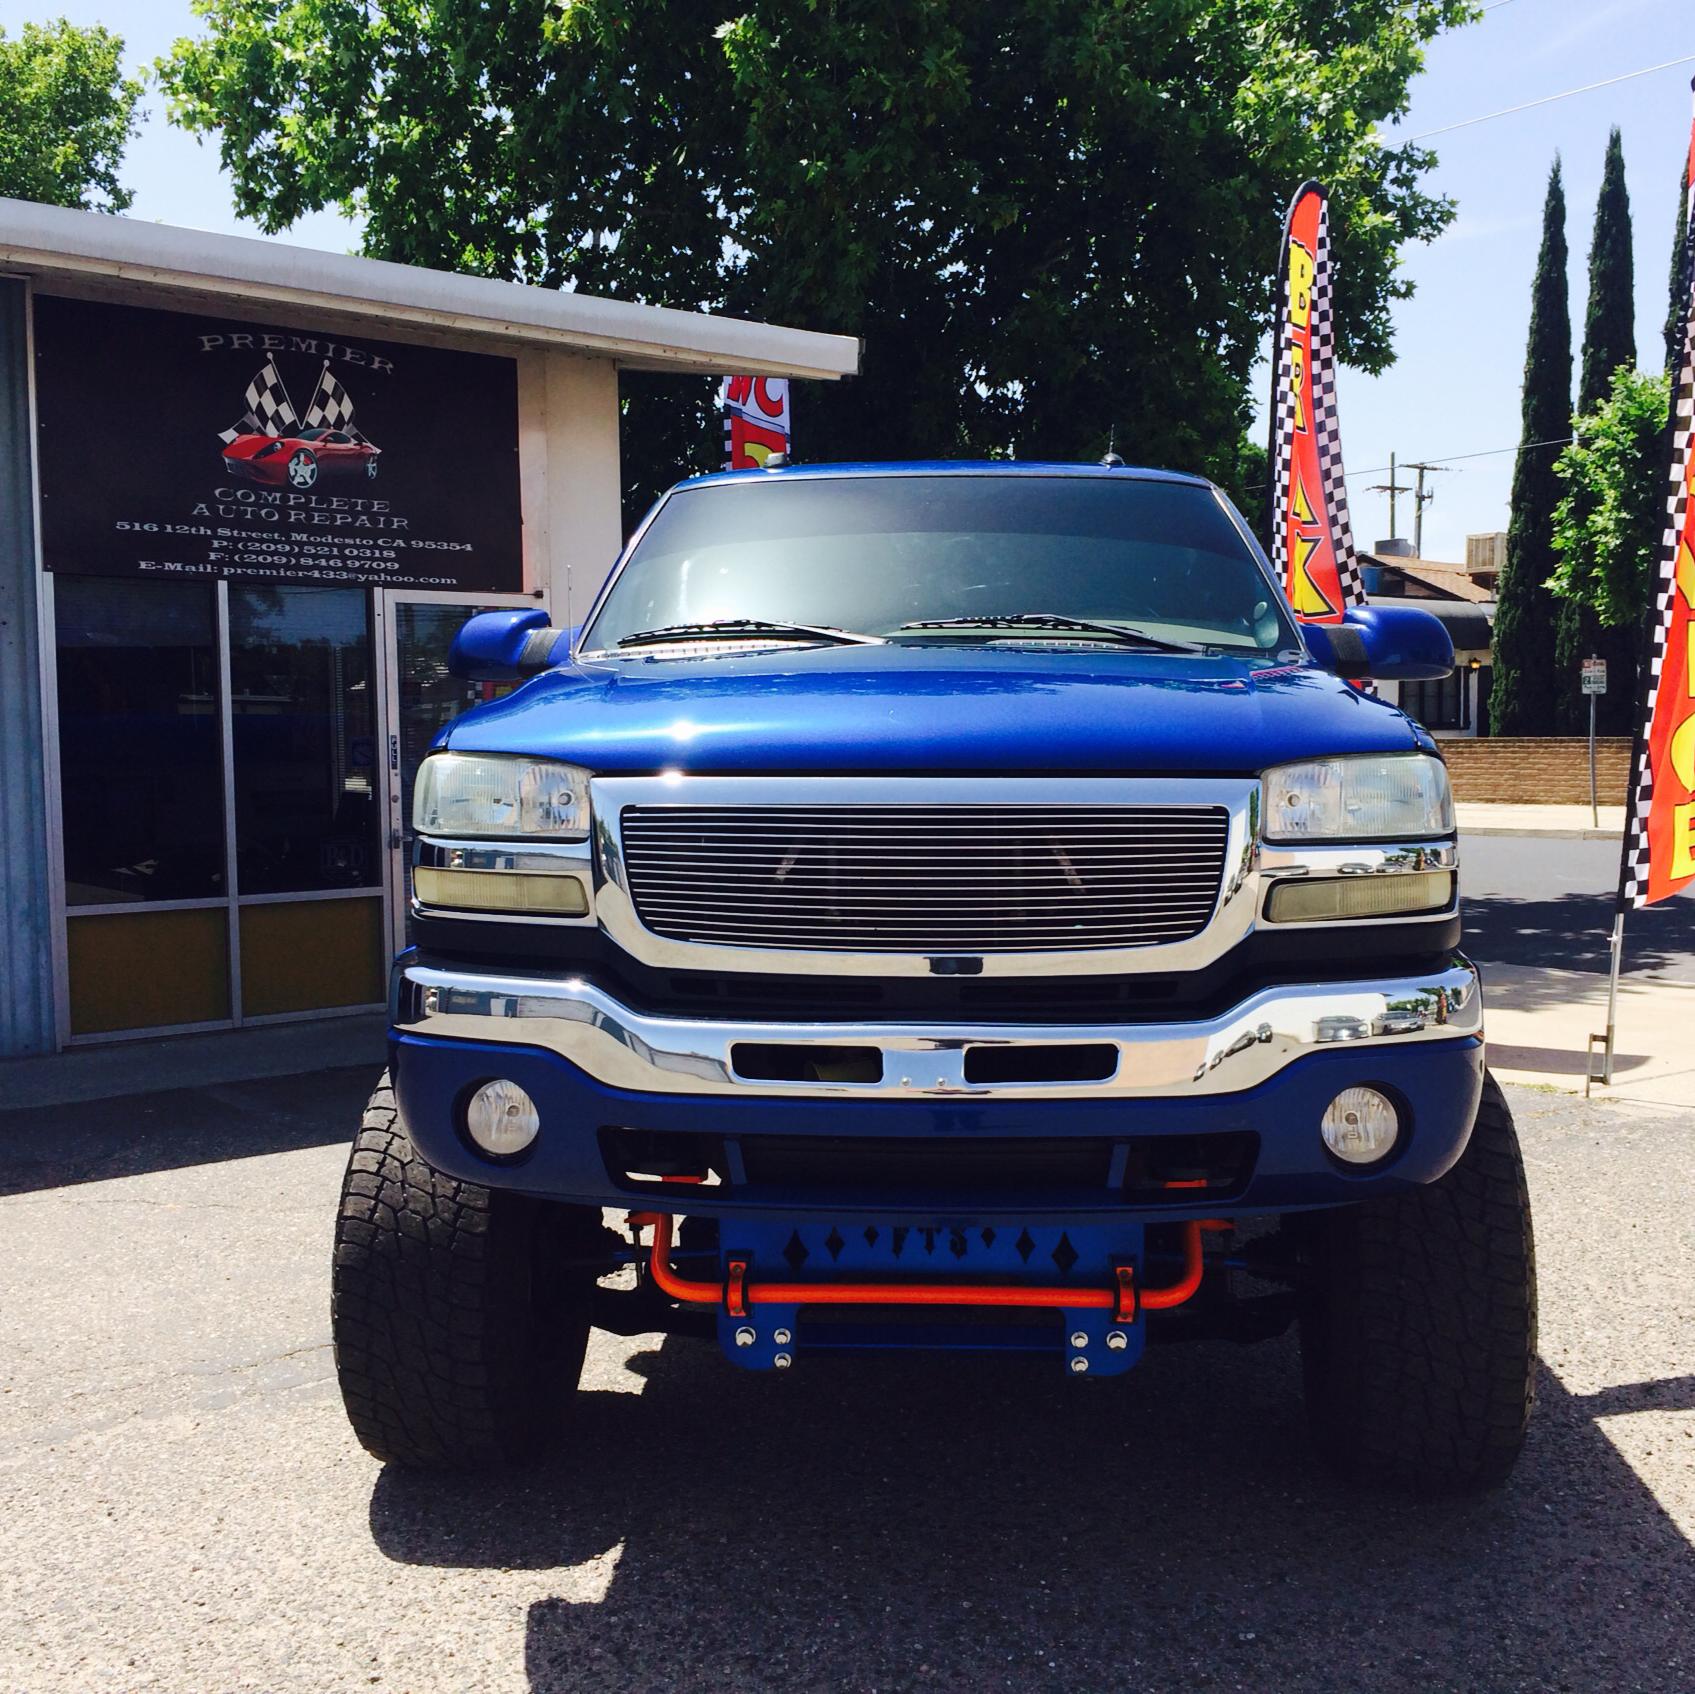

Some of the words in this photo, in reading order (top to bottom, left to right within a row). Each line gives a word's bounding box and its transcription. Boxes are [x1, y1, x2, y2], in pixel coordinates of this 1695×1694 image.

[198, 333, 395, 375] PREMIER
[1288, 239, 1339, 619] BRAK
[214, 488, 390, 512] COMPLETE
[191, 503, 279, 521] AUTO
[288, 510, 409, 530] REPAIR
[115, 521, 159, 532] 516
[164, 523, 213, 535] 12th
[290, 532, 374, 546] Modesto
[377, 538, 407, 548] CA
[411, 540, 473, 551] 95354
[208, 552, 230, 561] F:
[233, 553, 296, 565] (209)
[300, 558, 343, 567] 846
[349, 560, 400, 570] 9709
[211, 540, 233, 549] P:
[237, 541, 299, 553] (209)
[303, 545, 340, 555] 521
[344, 548, 396, 558] 0318
[138, 561, 218, 573] E-Mail:
[222, 566, 458, 585] premier433@yahoo.com
